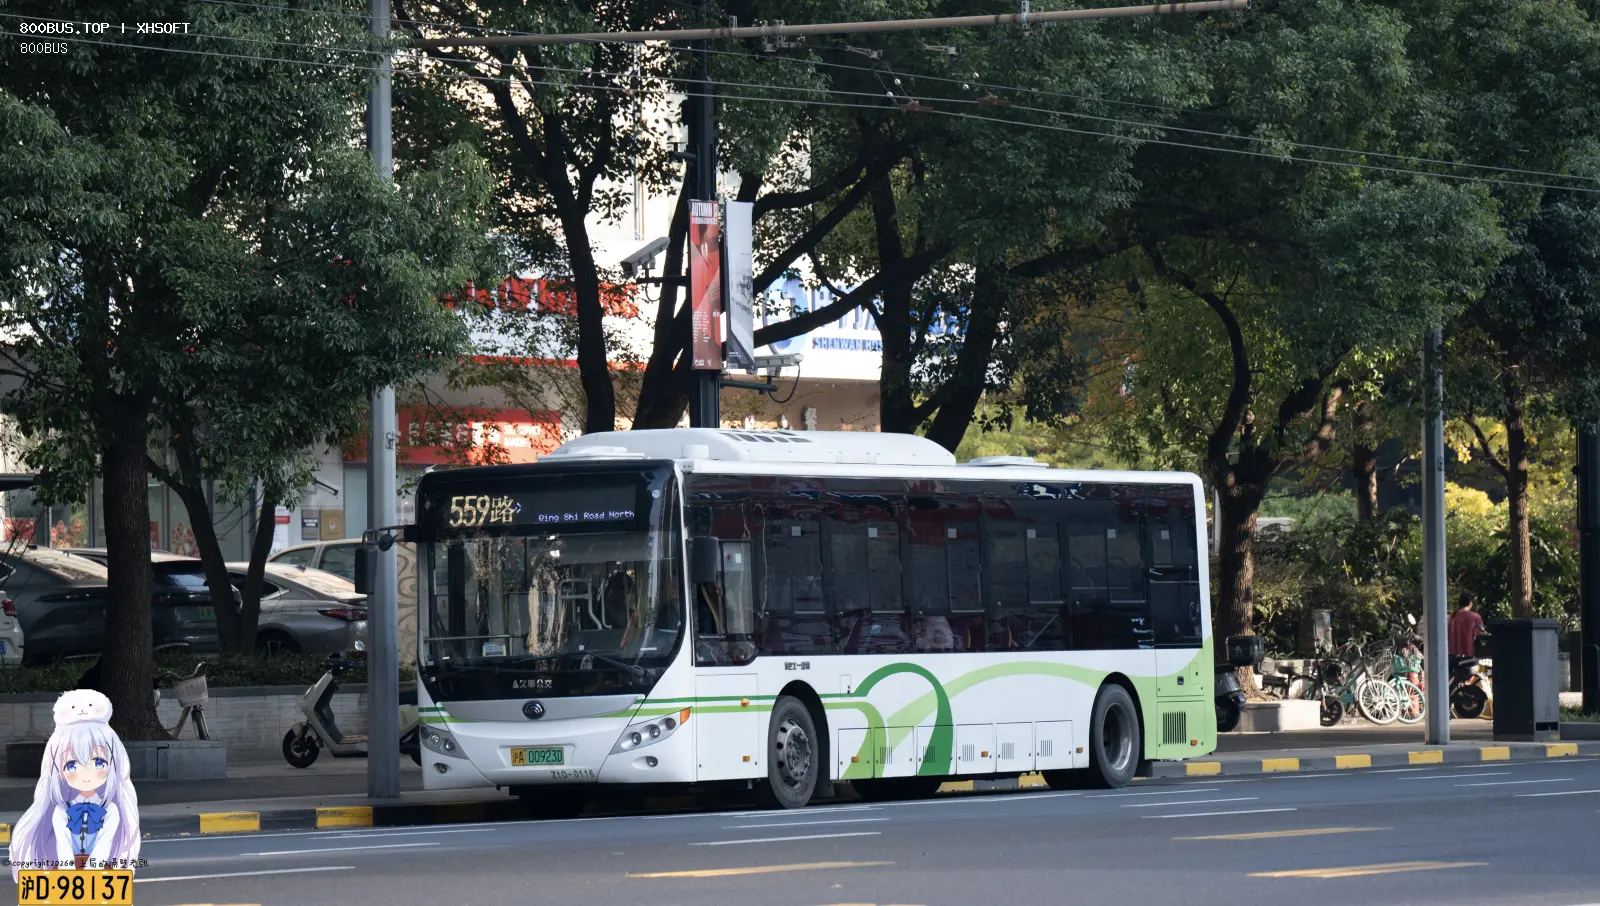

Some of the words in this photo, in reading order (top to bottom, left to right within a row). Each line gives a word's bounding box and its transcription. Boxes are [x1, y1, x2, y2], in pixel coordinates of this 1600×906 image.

[812, 337, 862, 351] SHENWAN
[449, 494, 516, 527] 559路
[563, 512, 579, 521] Shi
[583, 511, 605, 520] Road
[608, 510, 635, 519] North
[550, 769, 595, 779] Z1D-0116
